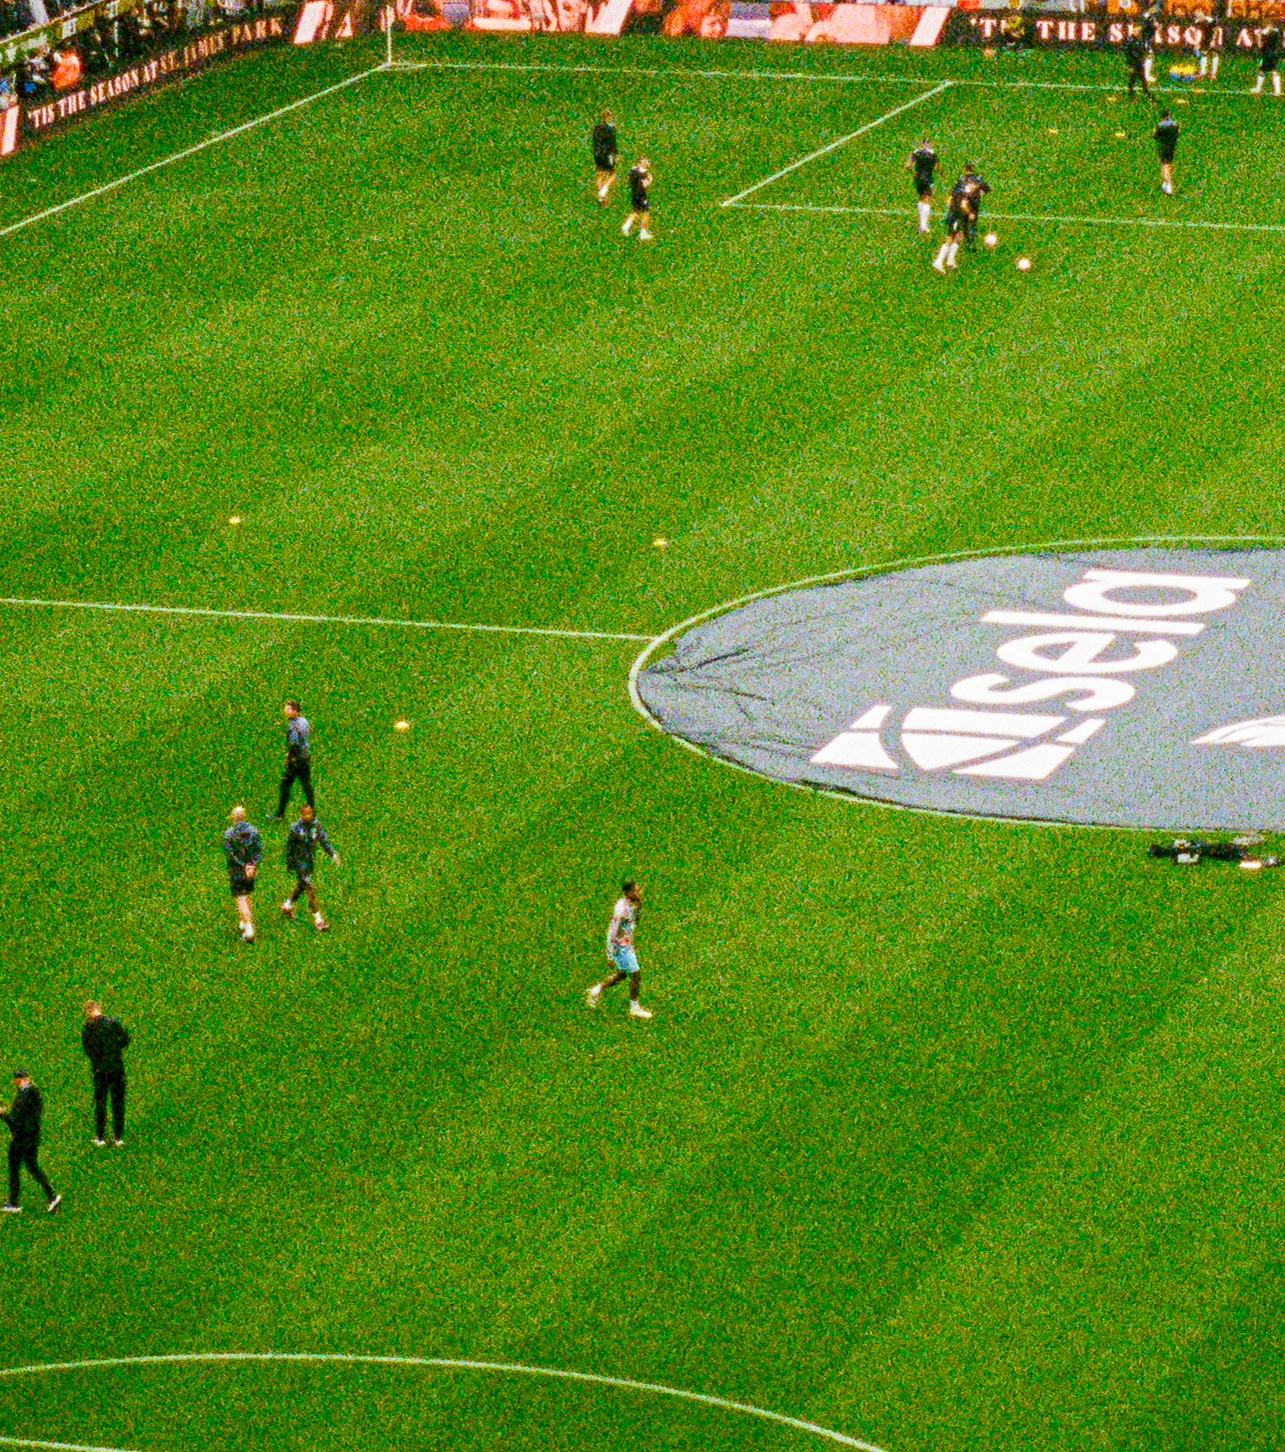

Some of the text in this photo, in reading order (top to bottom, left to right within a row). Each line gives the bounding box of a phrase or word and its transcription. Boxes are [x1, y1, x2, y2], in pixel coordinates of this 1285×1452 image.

[28, 103, 55, 129] 'TIS
[57, 90, 87, 118] THE
[89, 68, 141, 107] SEASON
[143, 58, 159, 84] AT
[231, 17, 282, 44] PARK
[1036, 20, 1095, 41] THE
[950, 568, 1251, 712] sela
